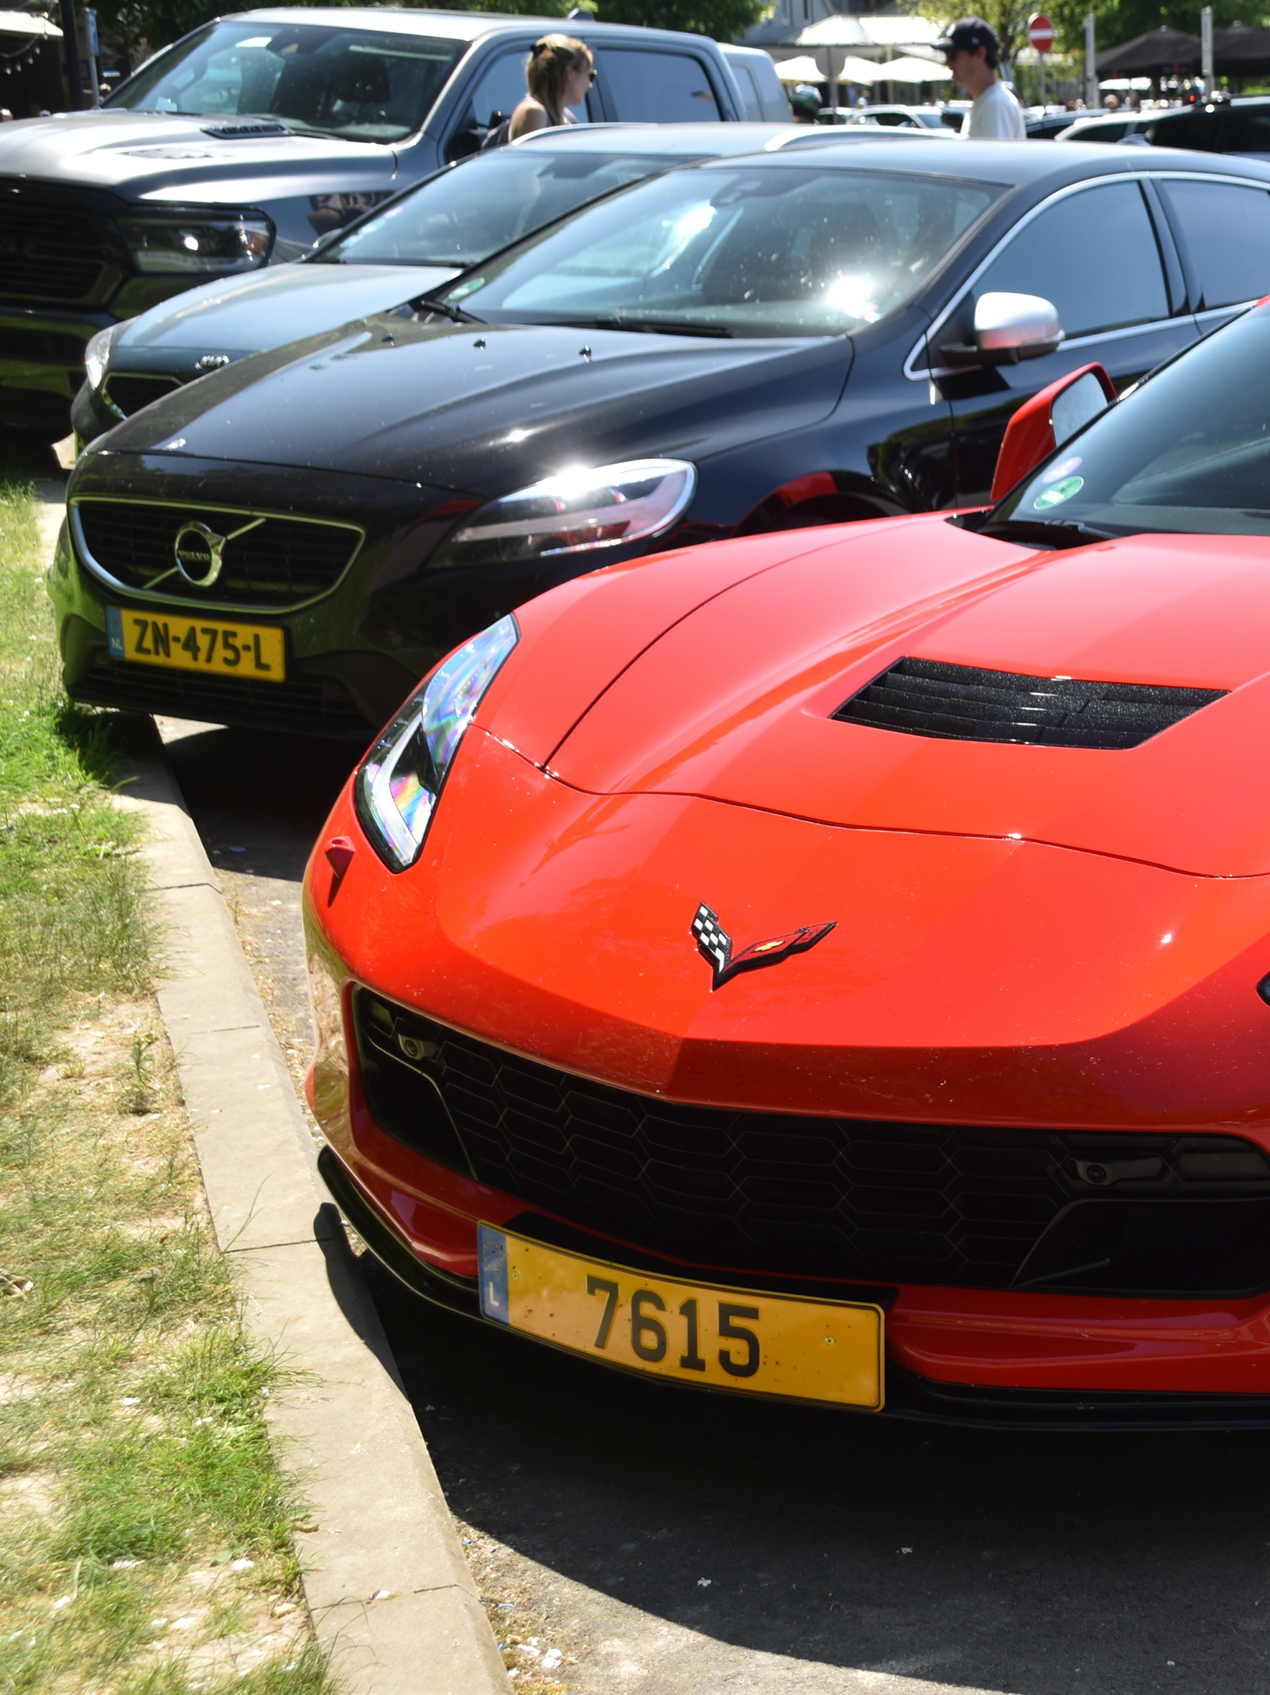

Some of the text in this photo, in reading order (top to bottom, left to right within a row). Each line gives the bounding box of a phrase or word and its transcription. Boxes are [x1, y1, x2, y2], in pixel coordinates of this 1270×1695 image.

[178, 550, 210, 561] VOLVO
[112, 637, 123, 650] NL
[133, 618, 271, 671] ZN-475-L
[488, 1281, 500, 1307] L
[586, 1274, 760, 1377] 7615
